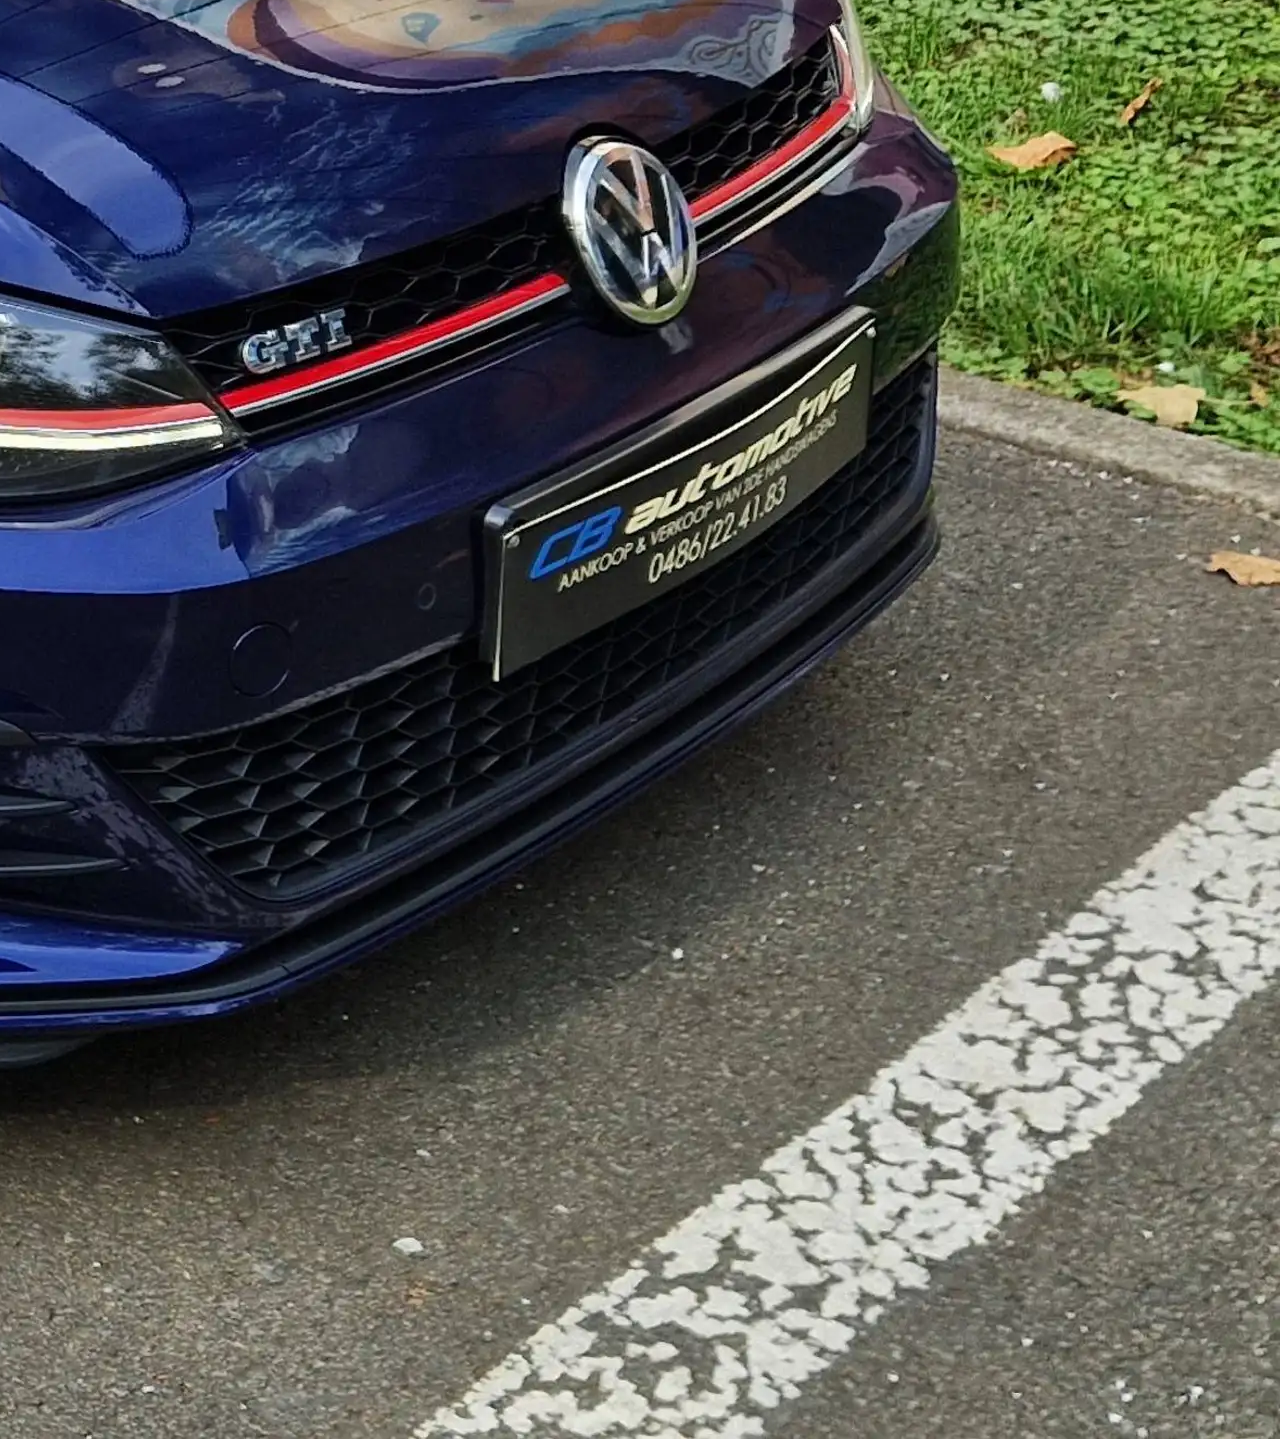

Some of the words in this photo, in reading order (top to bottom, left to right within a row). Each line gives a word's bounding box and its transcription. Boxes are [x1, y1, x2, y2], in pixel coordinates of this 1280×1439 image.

[241, 307, 354, 374] GTI
[529, 505, 622, 579] CB
[624, 363, 858, 534] automotive
[556, 542, 634, 593] AANKOOP
[635, 536, 647, 555] &
[650, 500, 714, 546] VERKOOP
[715, 481, 743, 510] VAN
[648, 475, 788, 584] 0486/22.41.83
